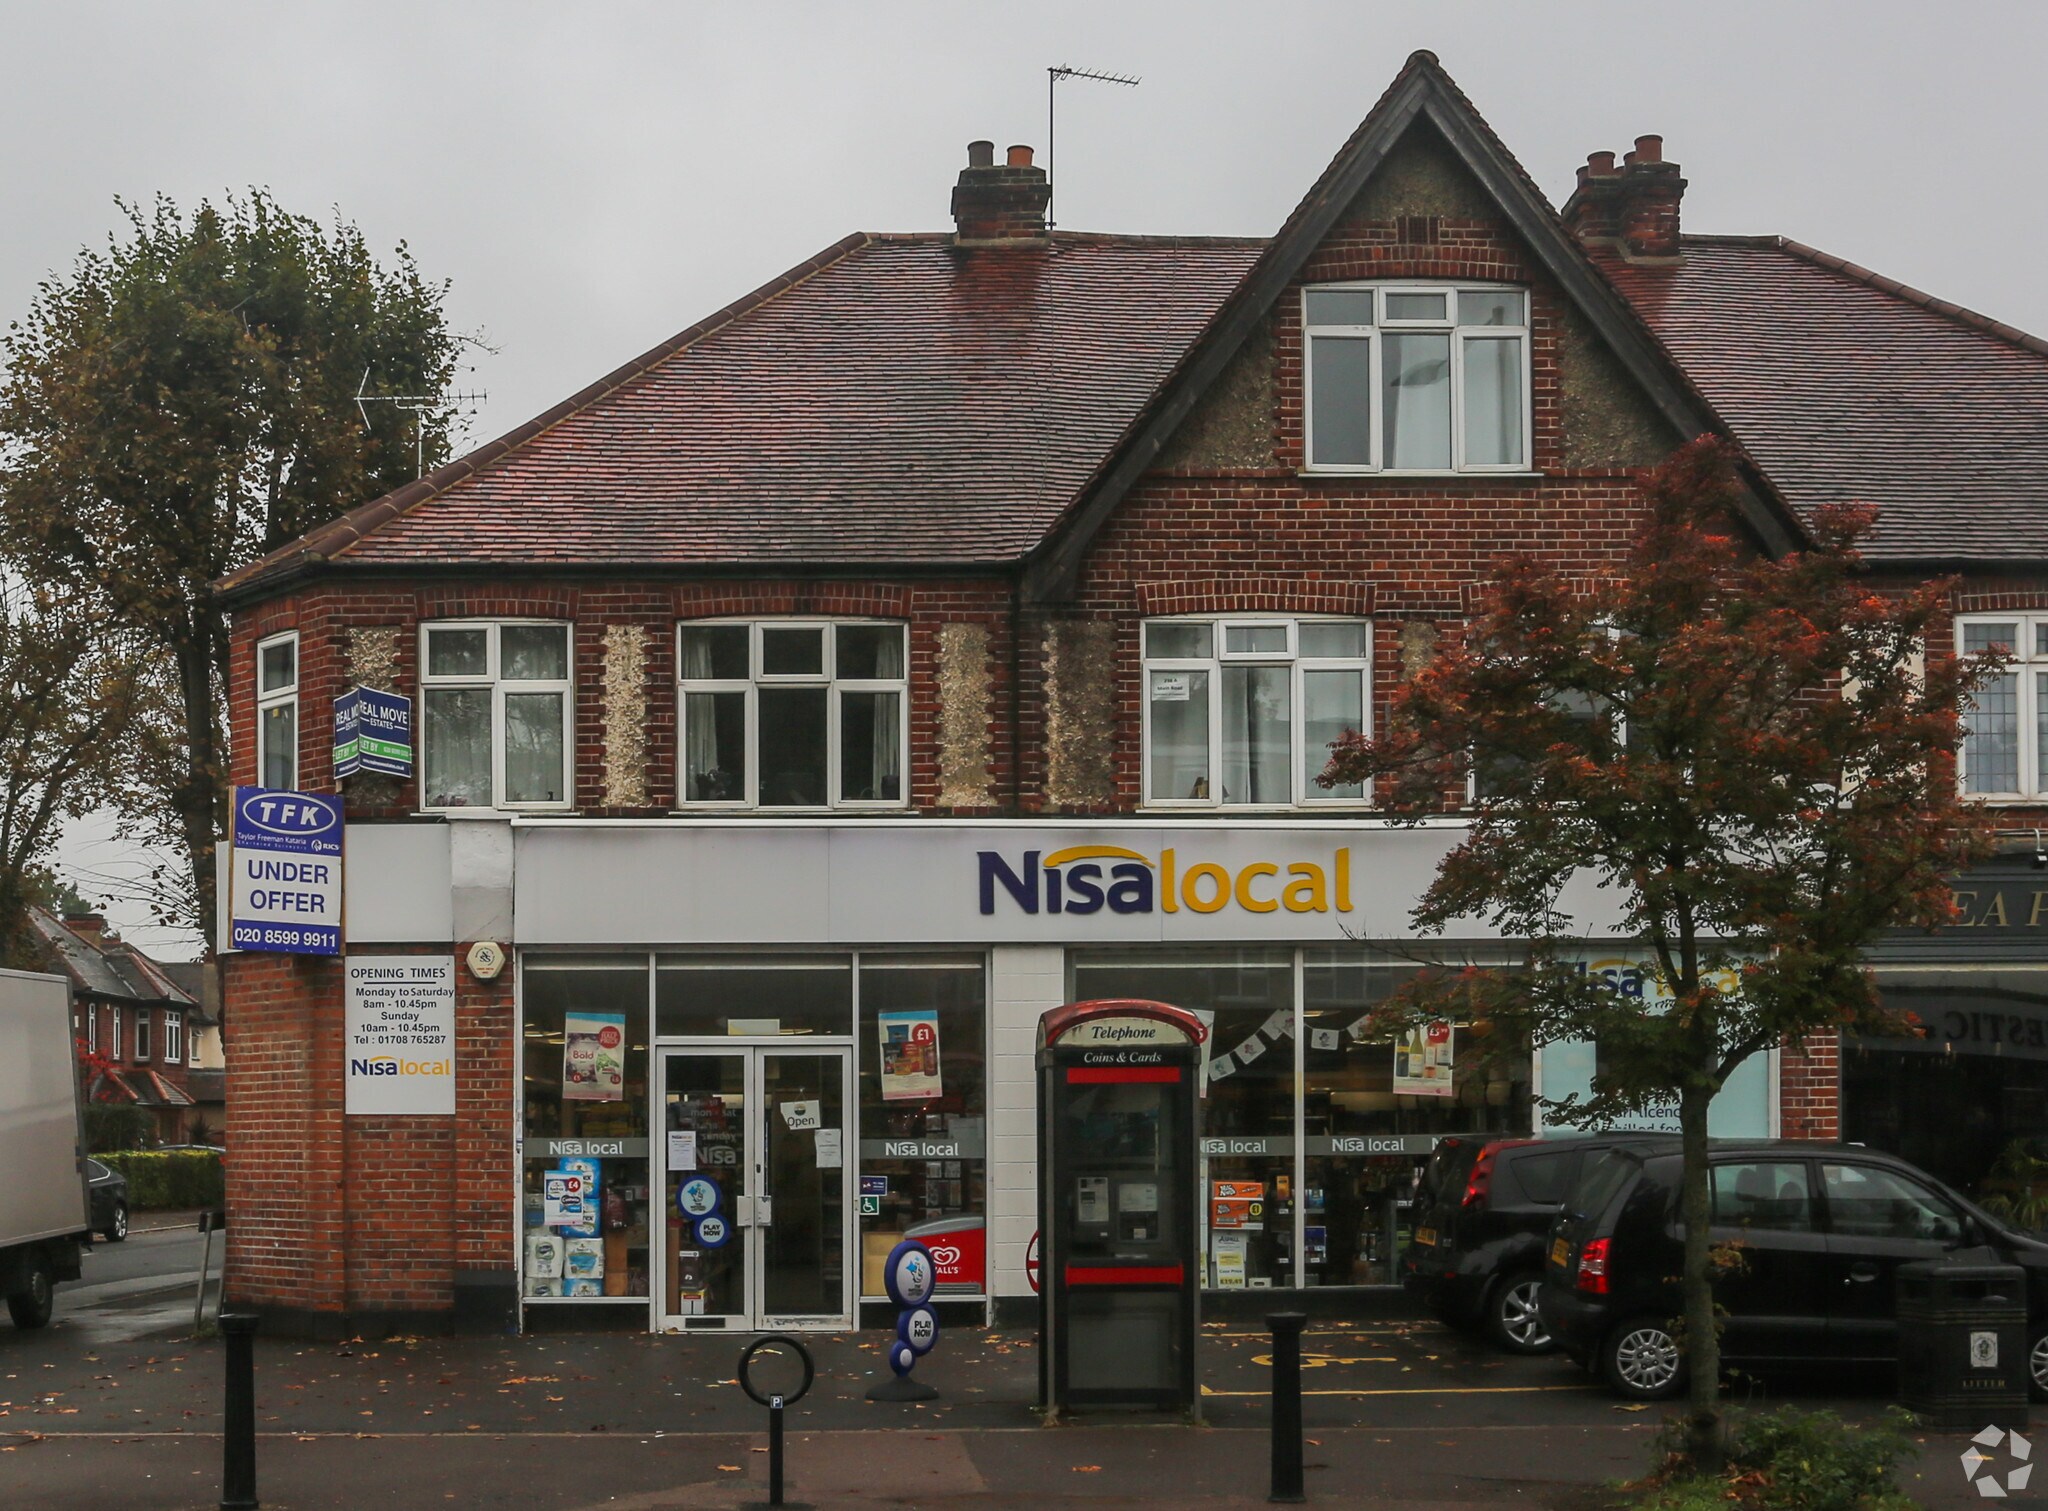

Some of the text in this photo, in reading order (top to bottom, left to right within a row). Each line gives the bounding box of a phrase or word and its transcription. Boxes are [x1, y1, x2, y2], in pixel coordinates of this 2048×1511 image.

[335, 703, 359, 726] REAL MO
[380, 706, 408, 725] MOVE
[370, 718, 394, 730] ESTATES
[370, 741, 379, 752] BY
[237, 832, 307, 845] Taylor Freeman Kataria
[237, 840, 271, 848] Chartered
[323, 843, 340, 851] RICS
[248, 859, 329, 885] UNDER
[249, 889, 325, 914] OFFER
[1944, 890, 2011, 927] EA
[234, 927, 336, 948] 020 8599 9911
[351, 968, 446, 979] OPENING TIMES
[355, 987, 455, 998] Monday to Saturday
[363, 1000, 385, 1009] 8am
[395, 1000, 437, 1010] 10.45pm
[381, 1012, 420, 1022] Sunday
[361, 1024, 388, 1033] 10am
[398, 1024, 440, 1034] 10.45pm
[917, 1028, 930, 1040] £1
[1092, 1025, 1156, 1041] Telephone
[354, 1035, 369, 1044] Tel
[378, 1035, 408, 1044] 01708
[411, 1035, 446, 1044] 765287
[573, 1050, 594, 1059] Bold
[1084, 1051, 1162, 1063] Coins & Cards
[690, 1108, 712, 1117] mon
[787, 1116, 815, 1128] Open
[549, 1140, 623, 1155] Nisa local
[885, 1141, 959, 1156] Nisa local
[1230, 1140, 1266, 1153] local
[1332, 1137, 1404, 1152] Nisa local
[568, 1180, 578, 1189] £4
[914, 1320, 932, 1329] PLAY
[914, 1329, 932, 1338] NOW
[773, 1397, 780, 1407] P
